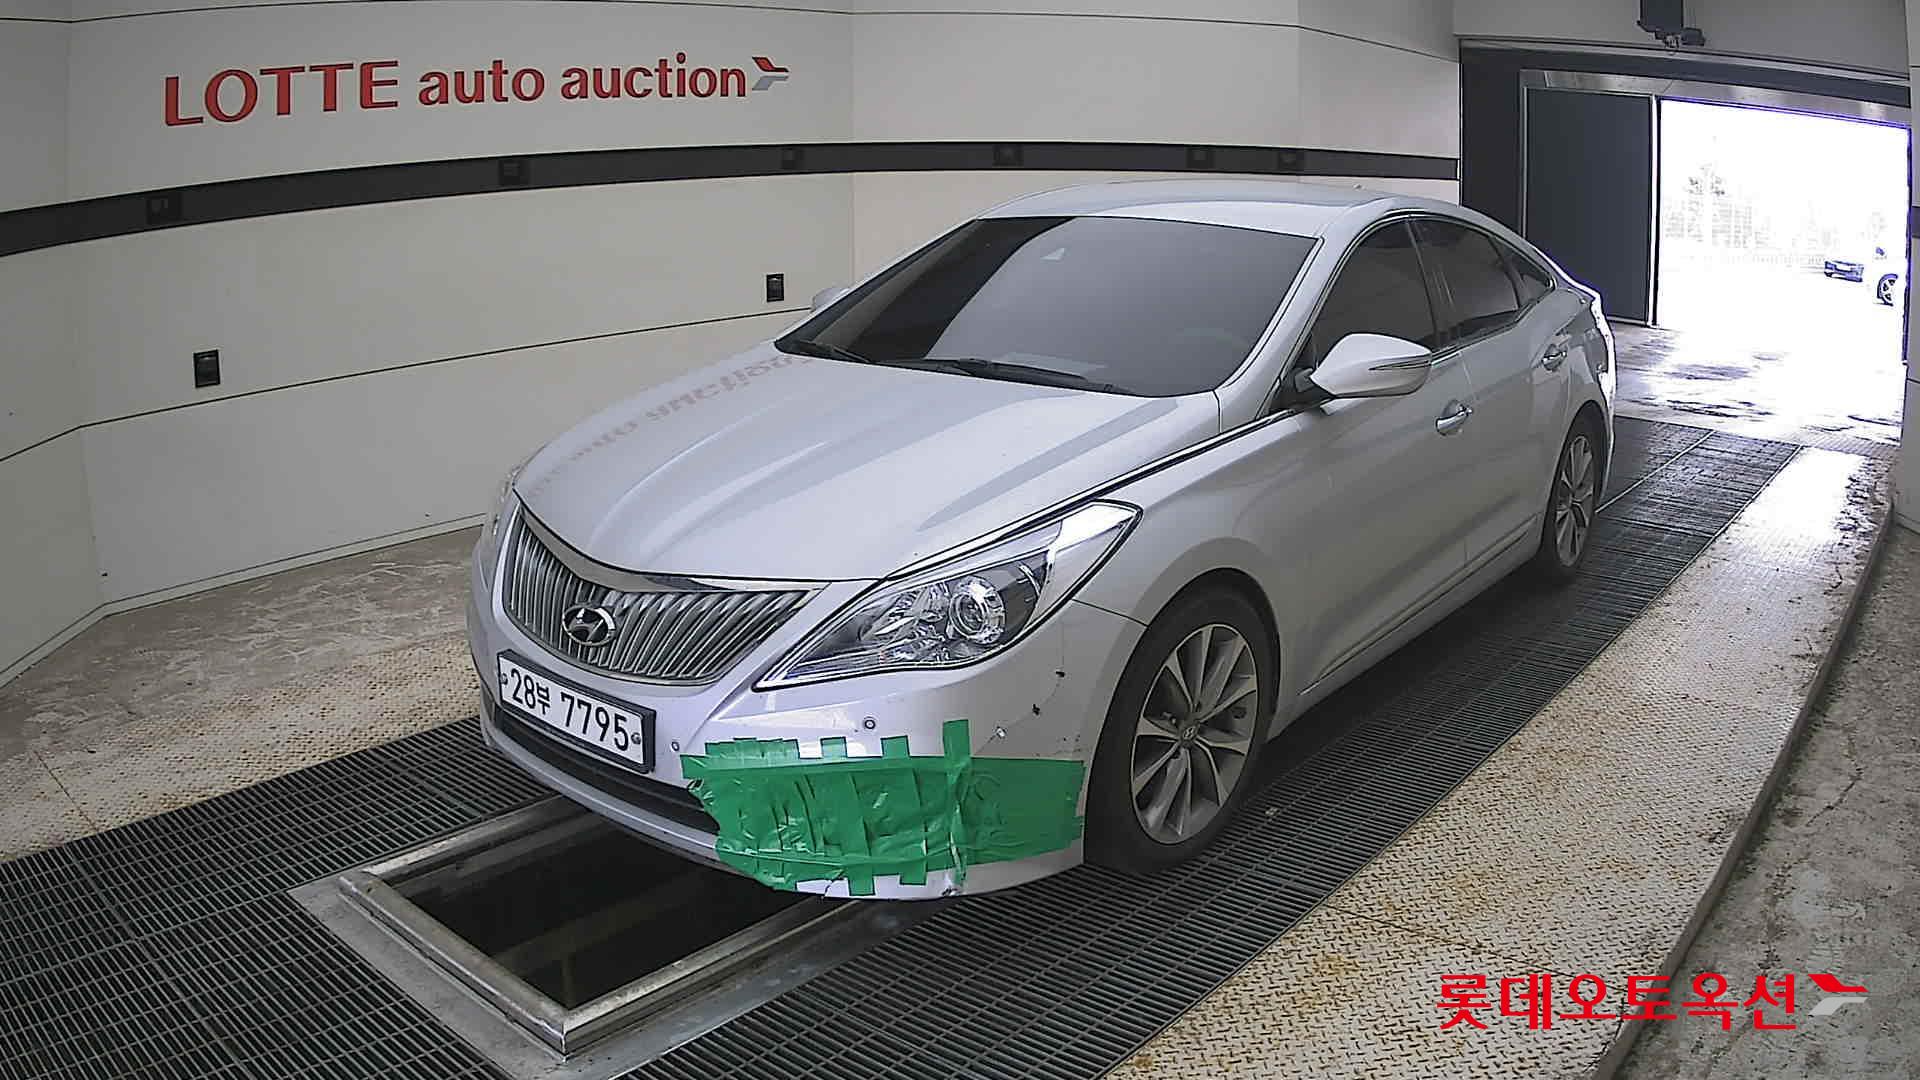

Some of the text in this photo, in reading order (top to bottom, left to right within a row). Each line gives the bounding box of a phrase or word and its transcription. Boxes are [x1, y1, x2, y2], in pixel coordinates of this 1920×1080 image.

[165, 53, 747, 126] LOTTE auto auction
[510, 668, 629, 751] 28부 7795
